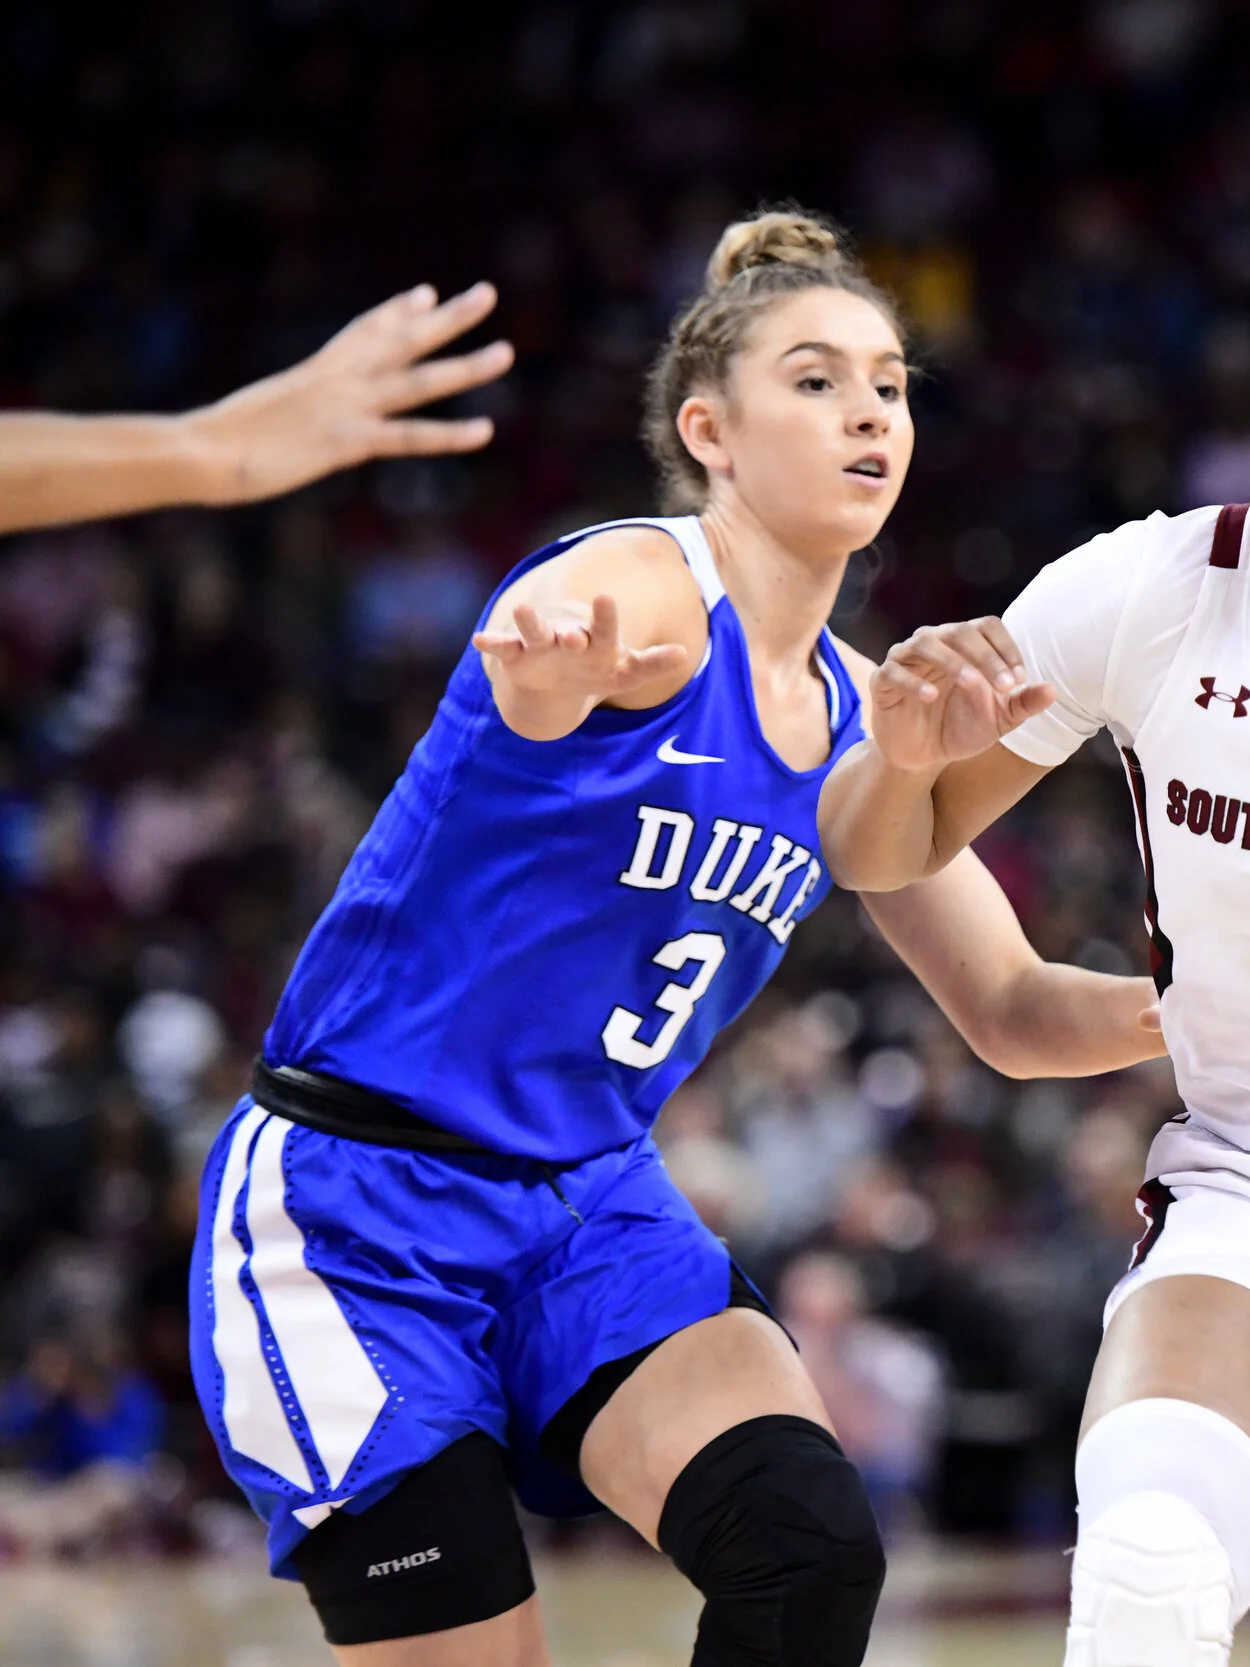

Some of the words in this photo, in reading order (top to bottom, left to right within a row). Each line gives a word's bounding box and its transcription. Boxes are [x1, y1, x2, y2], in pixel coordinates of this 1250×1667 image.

[618, 804, 822, 946] DUKE
[601, 931, 727, 1070] 3
[366, 1547, 442, 1578] ATHOS
